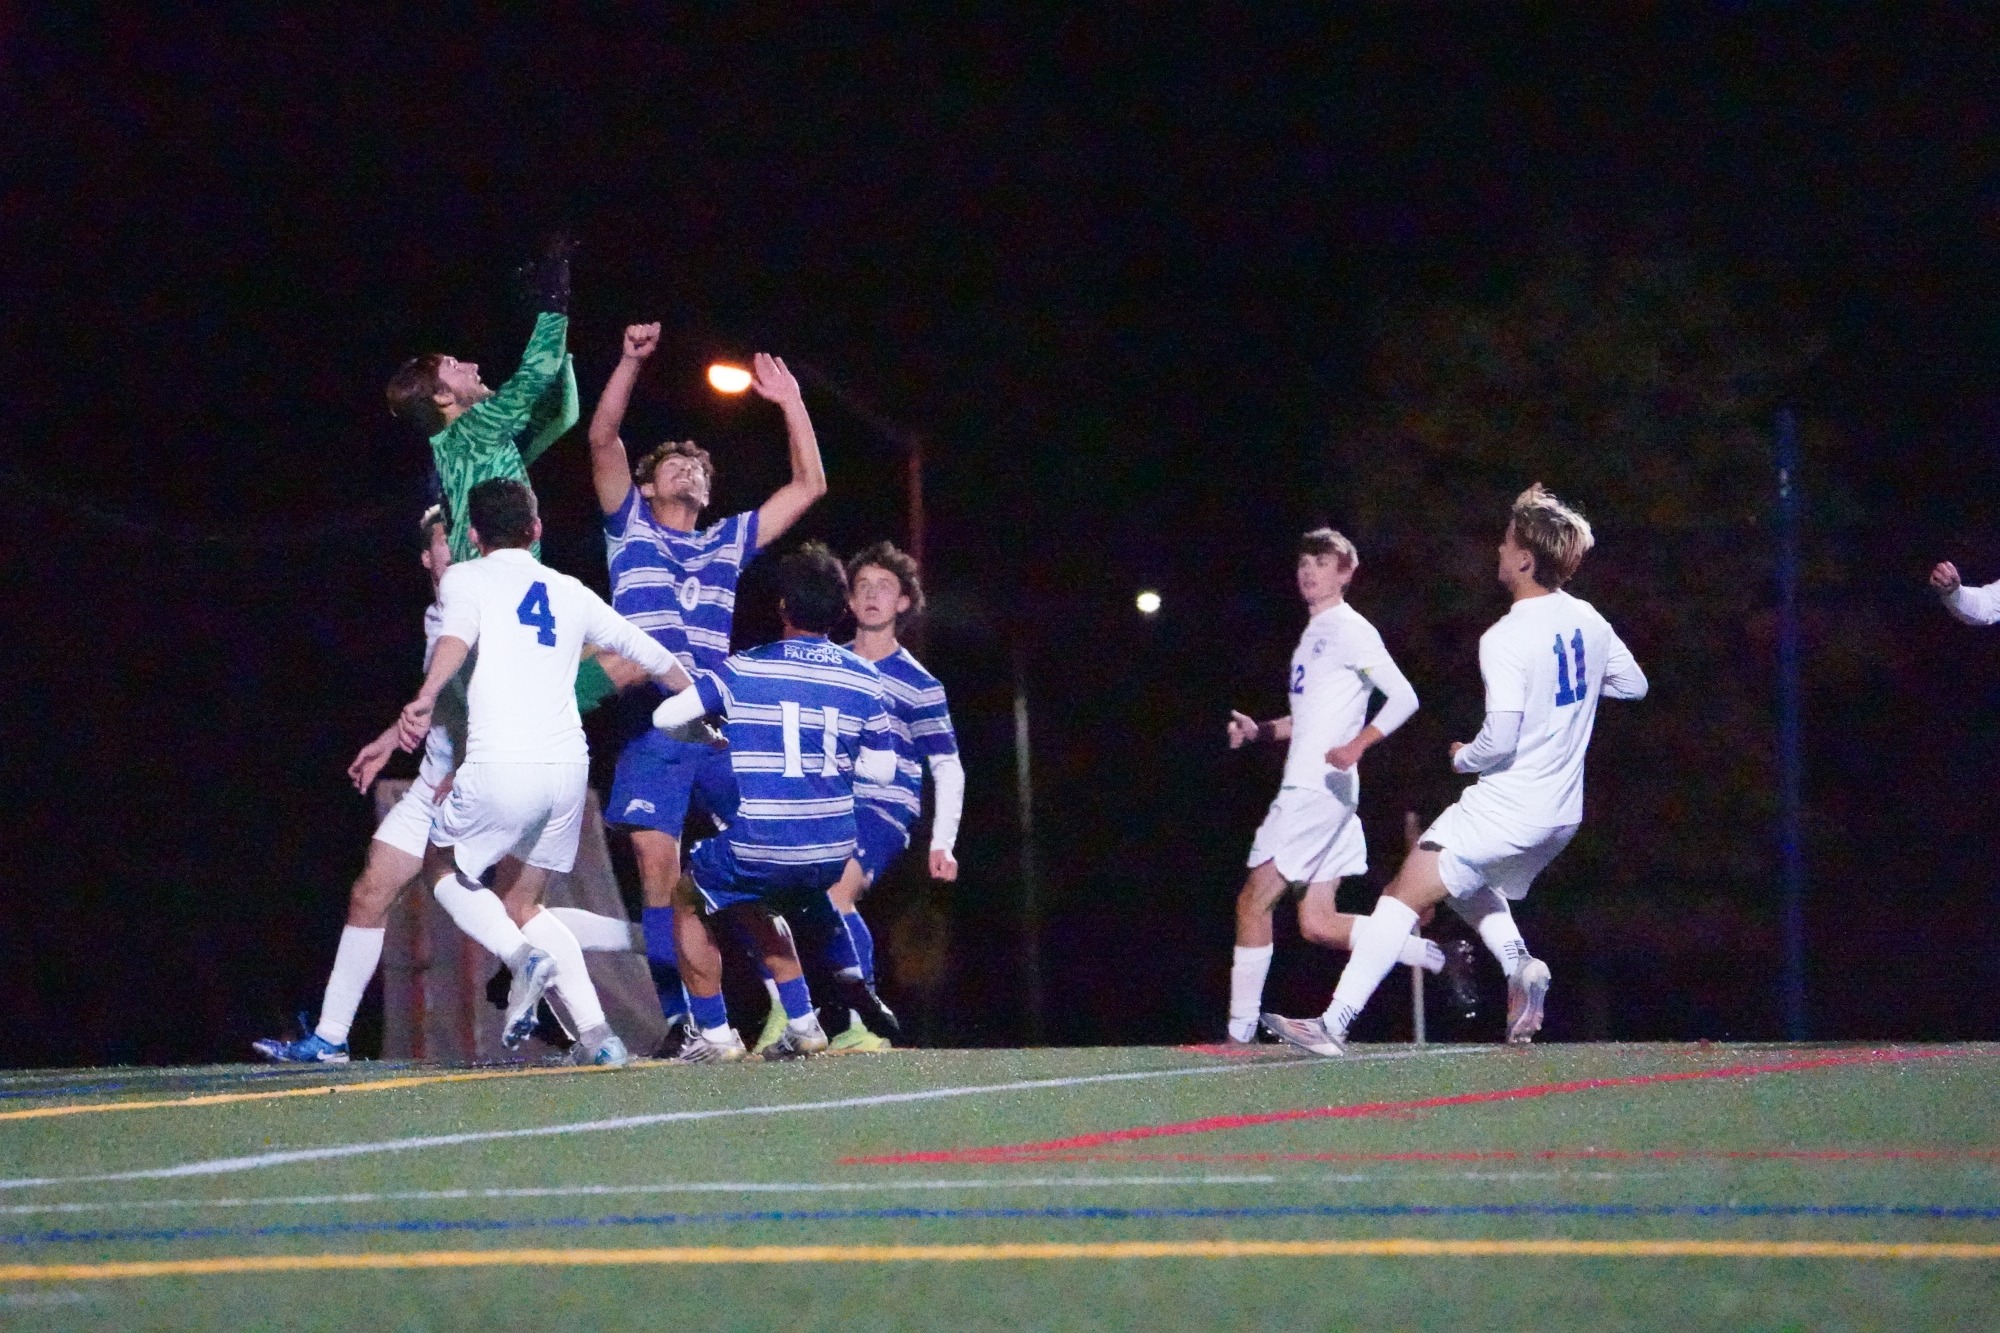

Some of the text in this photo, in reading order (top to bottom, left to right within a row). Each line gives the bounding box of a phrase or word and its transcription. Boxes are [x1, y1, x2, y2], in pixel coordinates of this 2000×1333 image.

[516, 580, 557, 647] 4
[680, 576, 700, 611] 0
[783, 648, 843, 665] FALCONS
[1289, 664, 1305, 695] 2
[1552, 628, 1587, 707] 11
[778, 700, 841, 778] 11
